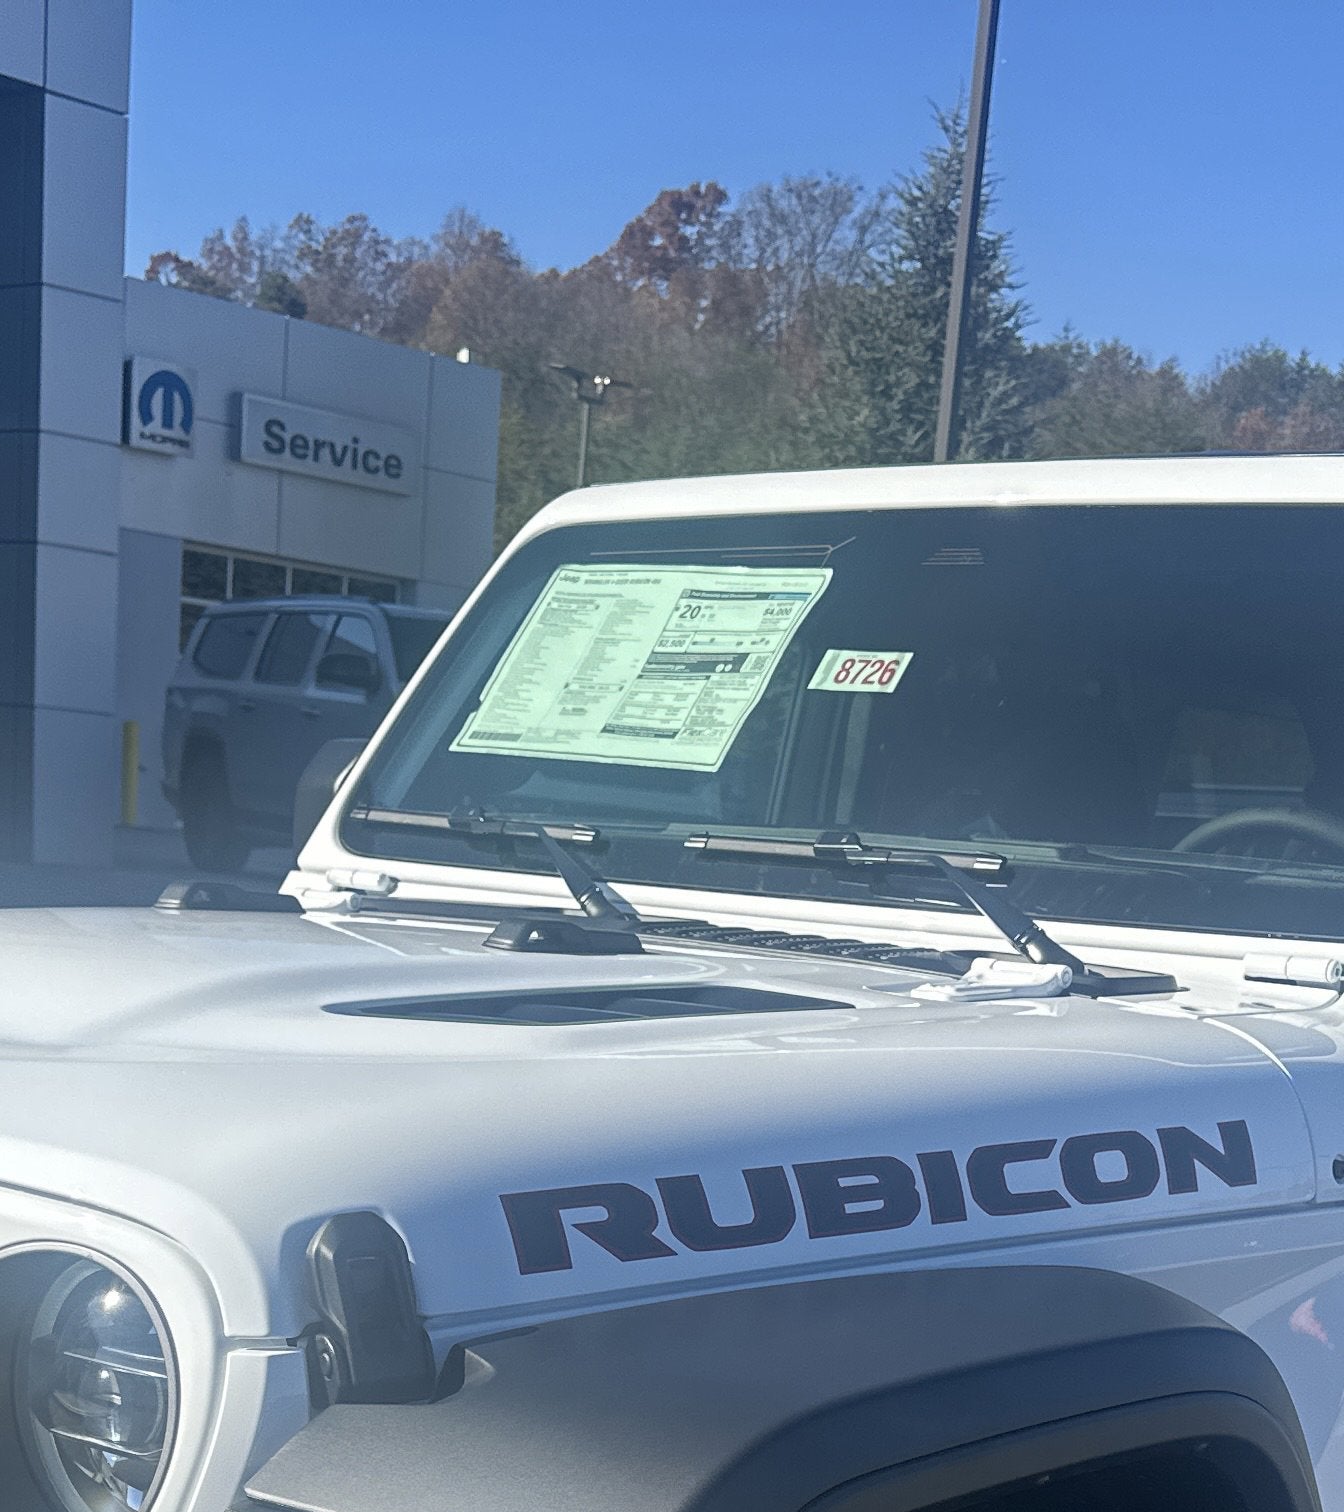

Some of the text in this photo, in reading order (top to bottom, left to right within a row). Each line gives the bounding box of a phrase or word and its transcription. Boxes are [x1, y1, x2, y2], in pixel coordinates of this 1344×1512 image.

[262, 418, 404, 480] Service
[678, 604, 702, 620] 20
[833, 658, 901, 686] 8726
[499, 1120, 1258, 1276] RUBICON
